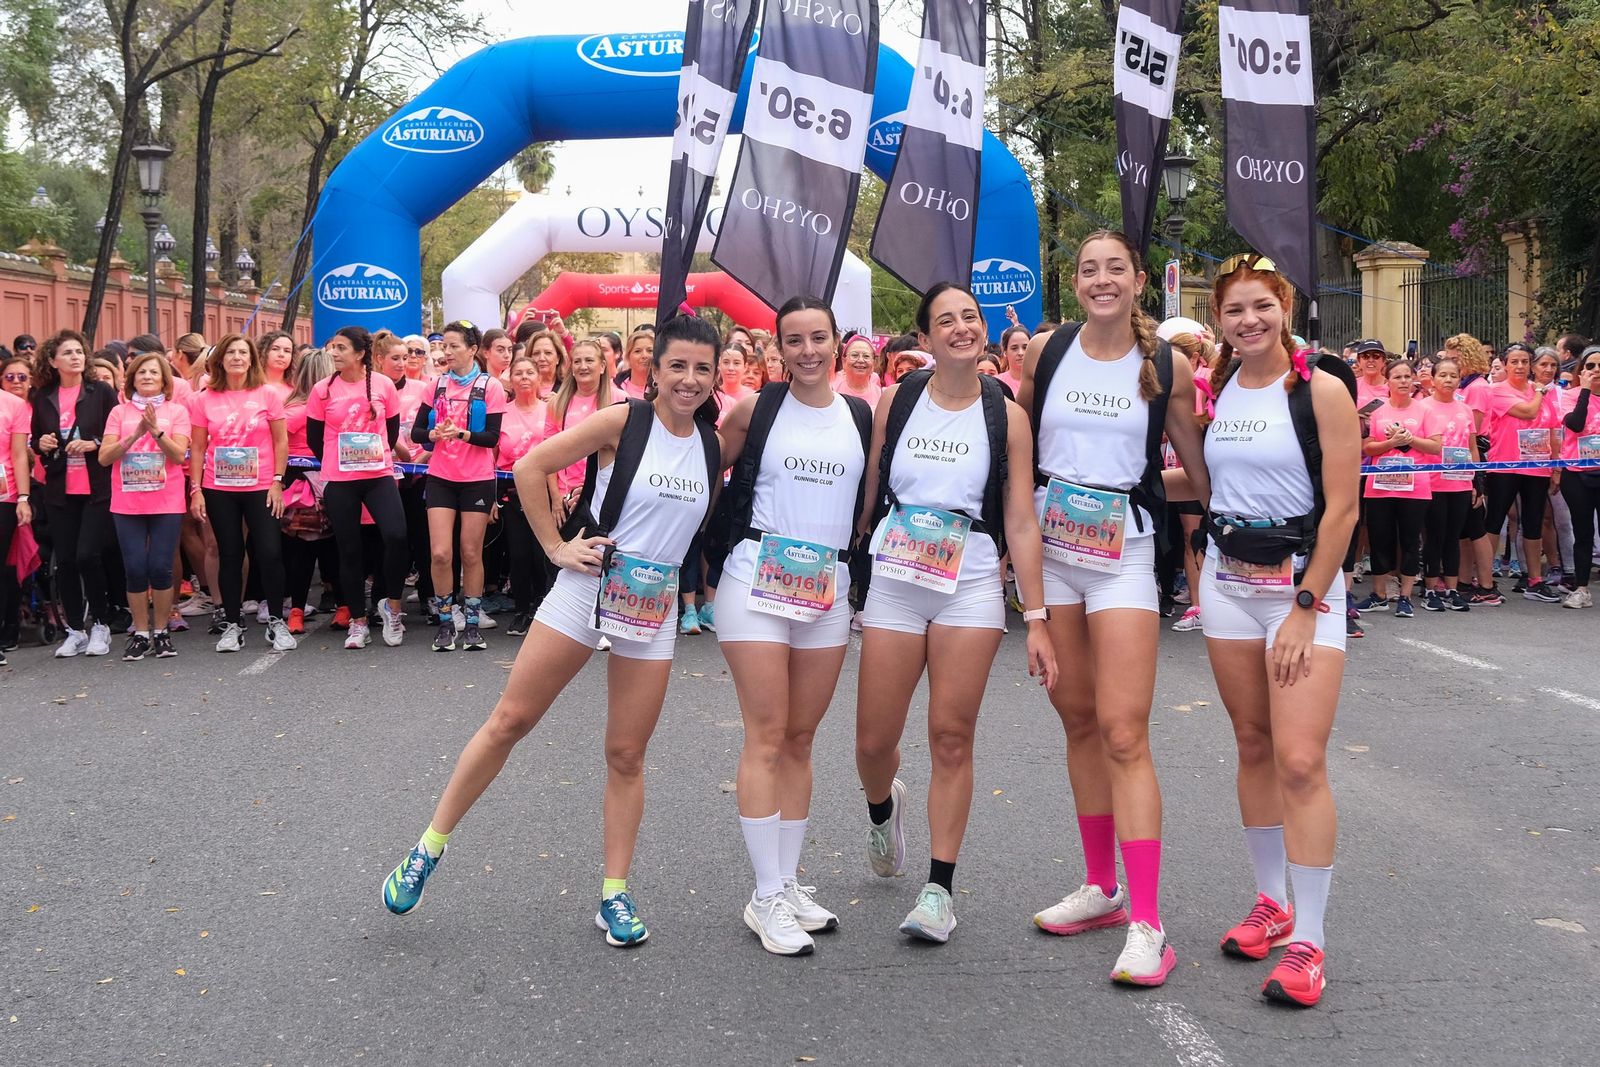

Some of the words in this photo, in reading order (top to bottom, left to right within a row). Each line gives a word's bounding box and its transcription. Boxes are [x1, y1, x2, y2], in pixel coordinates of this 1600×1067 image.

[590, 36, 684, 59] ASTUR
[389, 125, 476, 142] ASTURIANA
[577, 206, 725, 238] OYS
[322, 282, 402, 300] ASTURIANA
[599, 283, 630, 295] Sports
[970, 280, 1032, 295] STURIANA
[1066, 391, 1131, 409] OYSHO
[1074, 407, 1101, 416] RUNNING
[1212, 420, 1266, 433] OYSHO
[907, 437, 969, 455] OYSHO
[913, 453, 940, 461] RUNNING
[784, 456, 845, 477] OYSHO
[649, 473, 703, 494] OYSHO
[793, 475, 818, 484] RUNNING
[819, 478, 833, 486] CLUB
[659, 491, 682, 501] RUNNING
[1066, 520, 1097, 538] 016
[907, 540, 937, 557] 016
[1044, 547, 1068, 558] OYSHO
[880, 564, 906, 576] OYSHO
[782, 573, 815, 590] 016
[1223, 583, 1248, 592] OYSHO
[627, 594, 655, 610] 016
[757, 600, 786, 611] OYSHO
[605, 611, 624, 620] CARRERA
[600, 620, 628, 633] OYSHO
